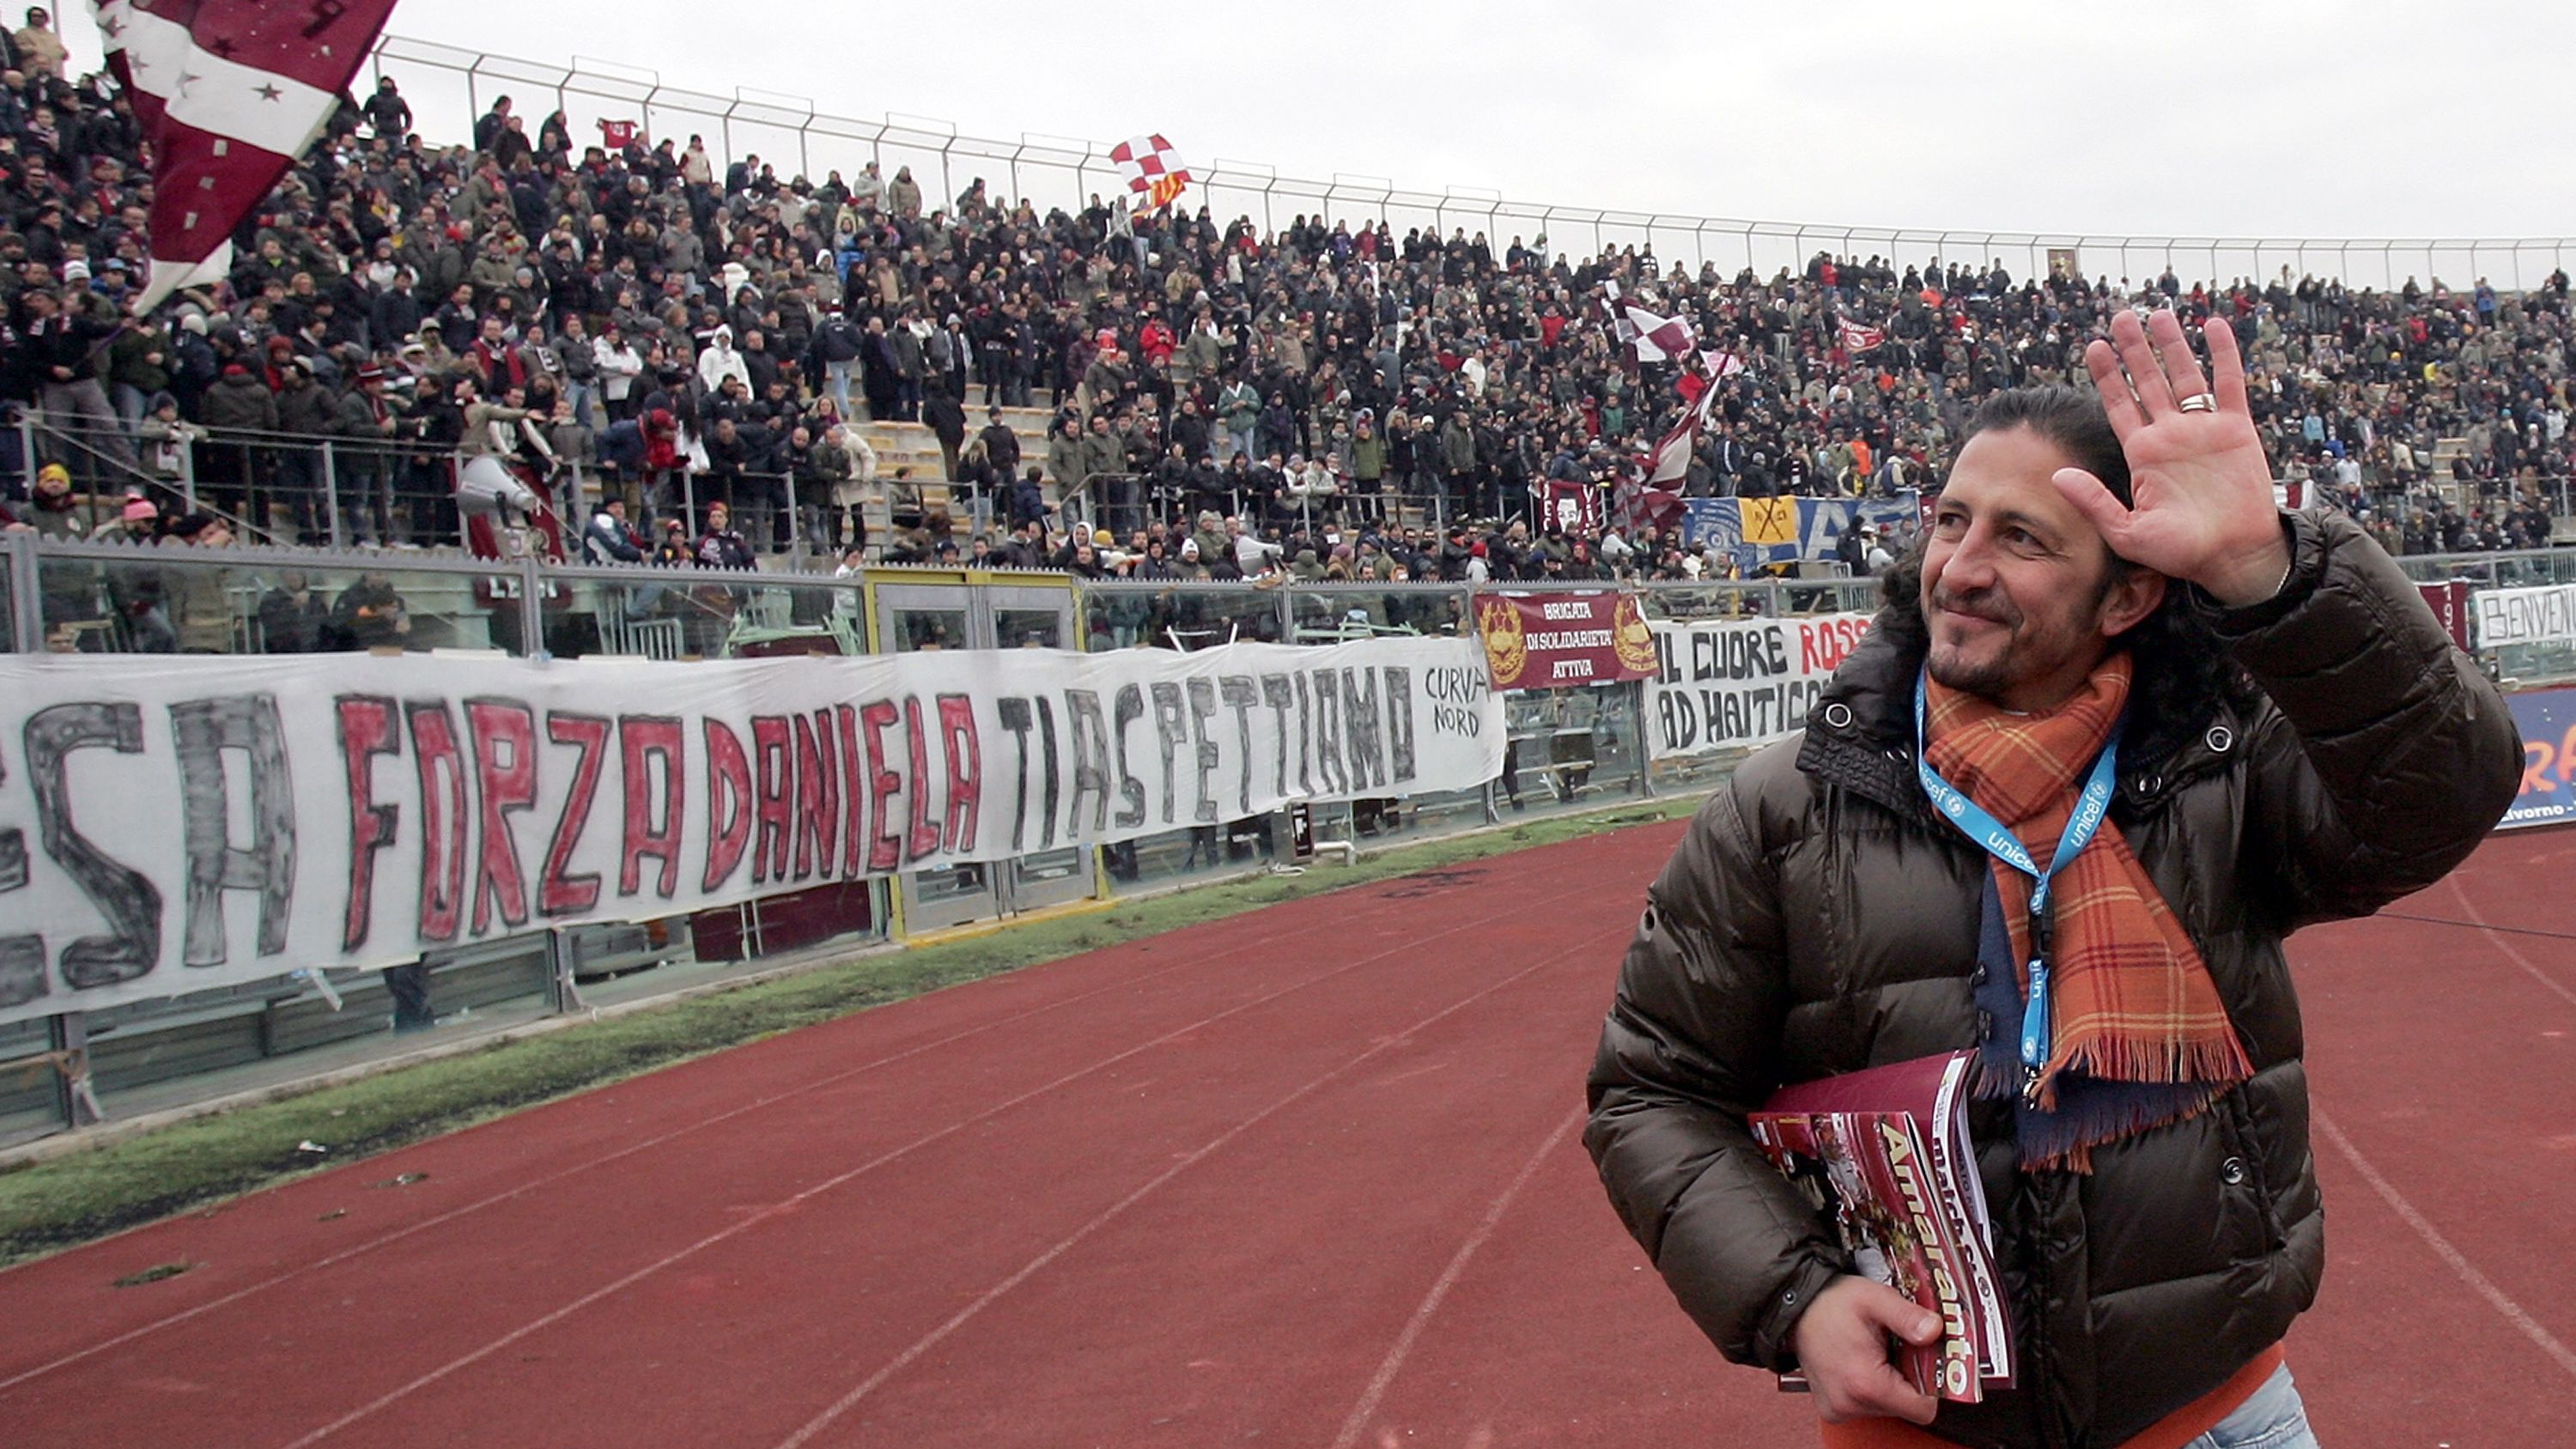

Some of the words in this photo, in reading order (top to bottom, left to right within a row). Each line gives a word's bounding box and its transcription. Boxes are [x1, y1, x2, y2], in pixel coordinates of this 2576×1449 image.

[1543, 602, 1593, 621] BRIGATA
[1552, 658, 1594, 679] ATTIVA
[1692, 625, 1788, 682] CUORE
[1425, 666, 1491, 704] CURVA
[1434, 703, 1479, 738] NORD
[2070, 793, 2102, 848] unicef
[0, 694, 297, 1006] SA
[335, 694, 684, 953] FORZA
[702, 693, 981, 894] DANIELA
[1880, 1121, 1973, 1396] Amaranto
